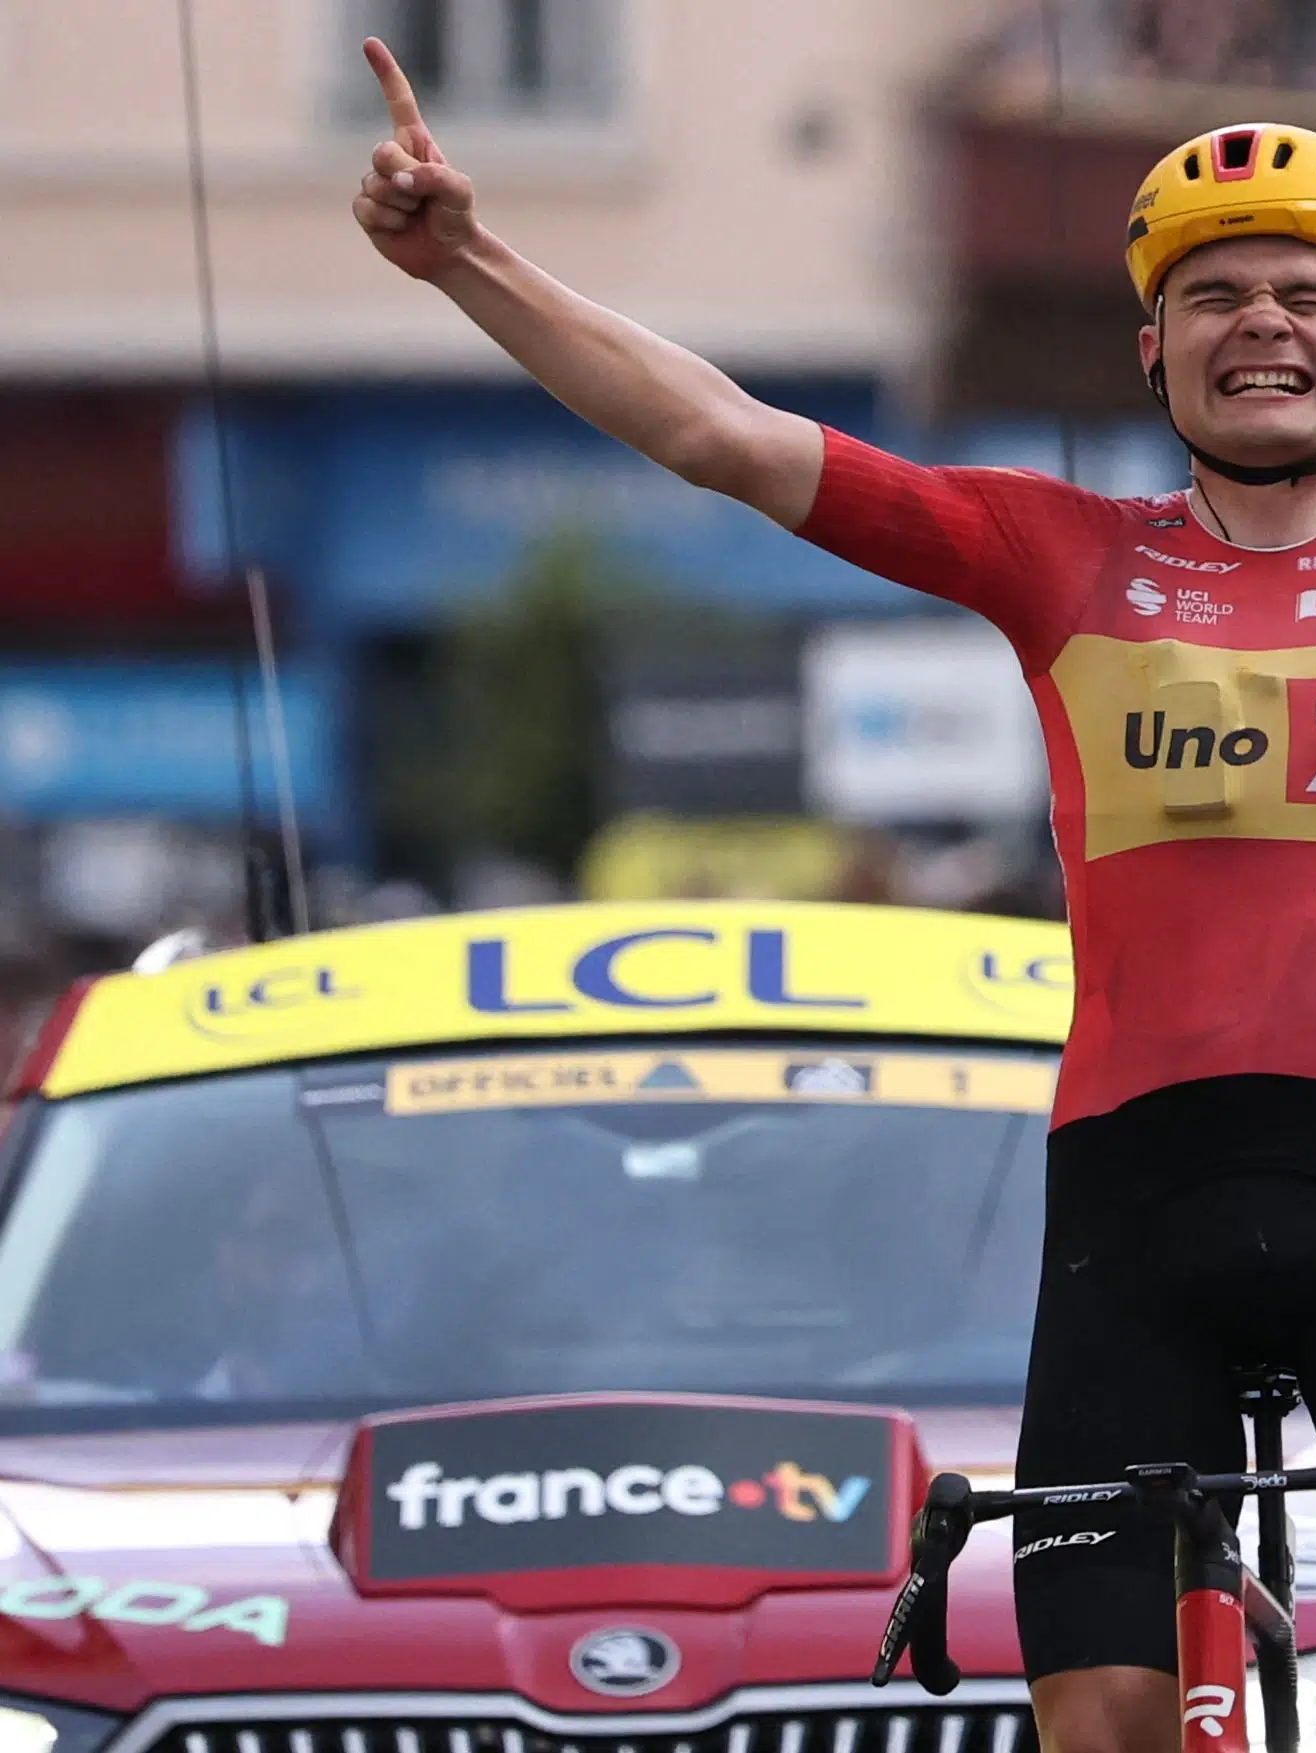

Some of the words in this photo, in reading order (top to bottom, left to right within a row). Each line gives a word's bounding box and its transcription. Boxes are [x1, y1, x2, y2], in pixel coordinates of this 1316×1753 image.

[1134, 545, 1243, 574] RIDLEY
[1176, 599, 1234, 615] WORLD
[1177, 588, 1209, 602] UCI
[1175, 610, 1218, 625] TEAM
[1124, 710, 1269, 769] Uno
[467, 928, 868, 1013] LCL
[206, 969, 364, 1014] LCL
[1042, 1489, 1122, 1506] RIDLEY
[1014, 1530, 1117, 1564] RIDLEY
[0, 1576, 287, 1647] ODA
[880, 1572, 925, 1661] SRAM
